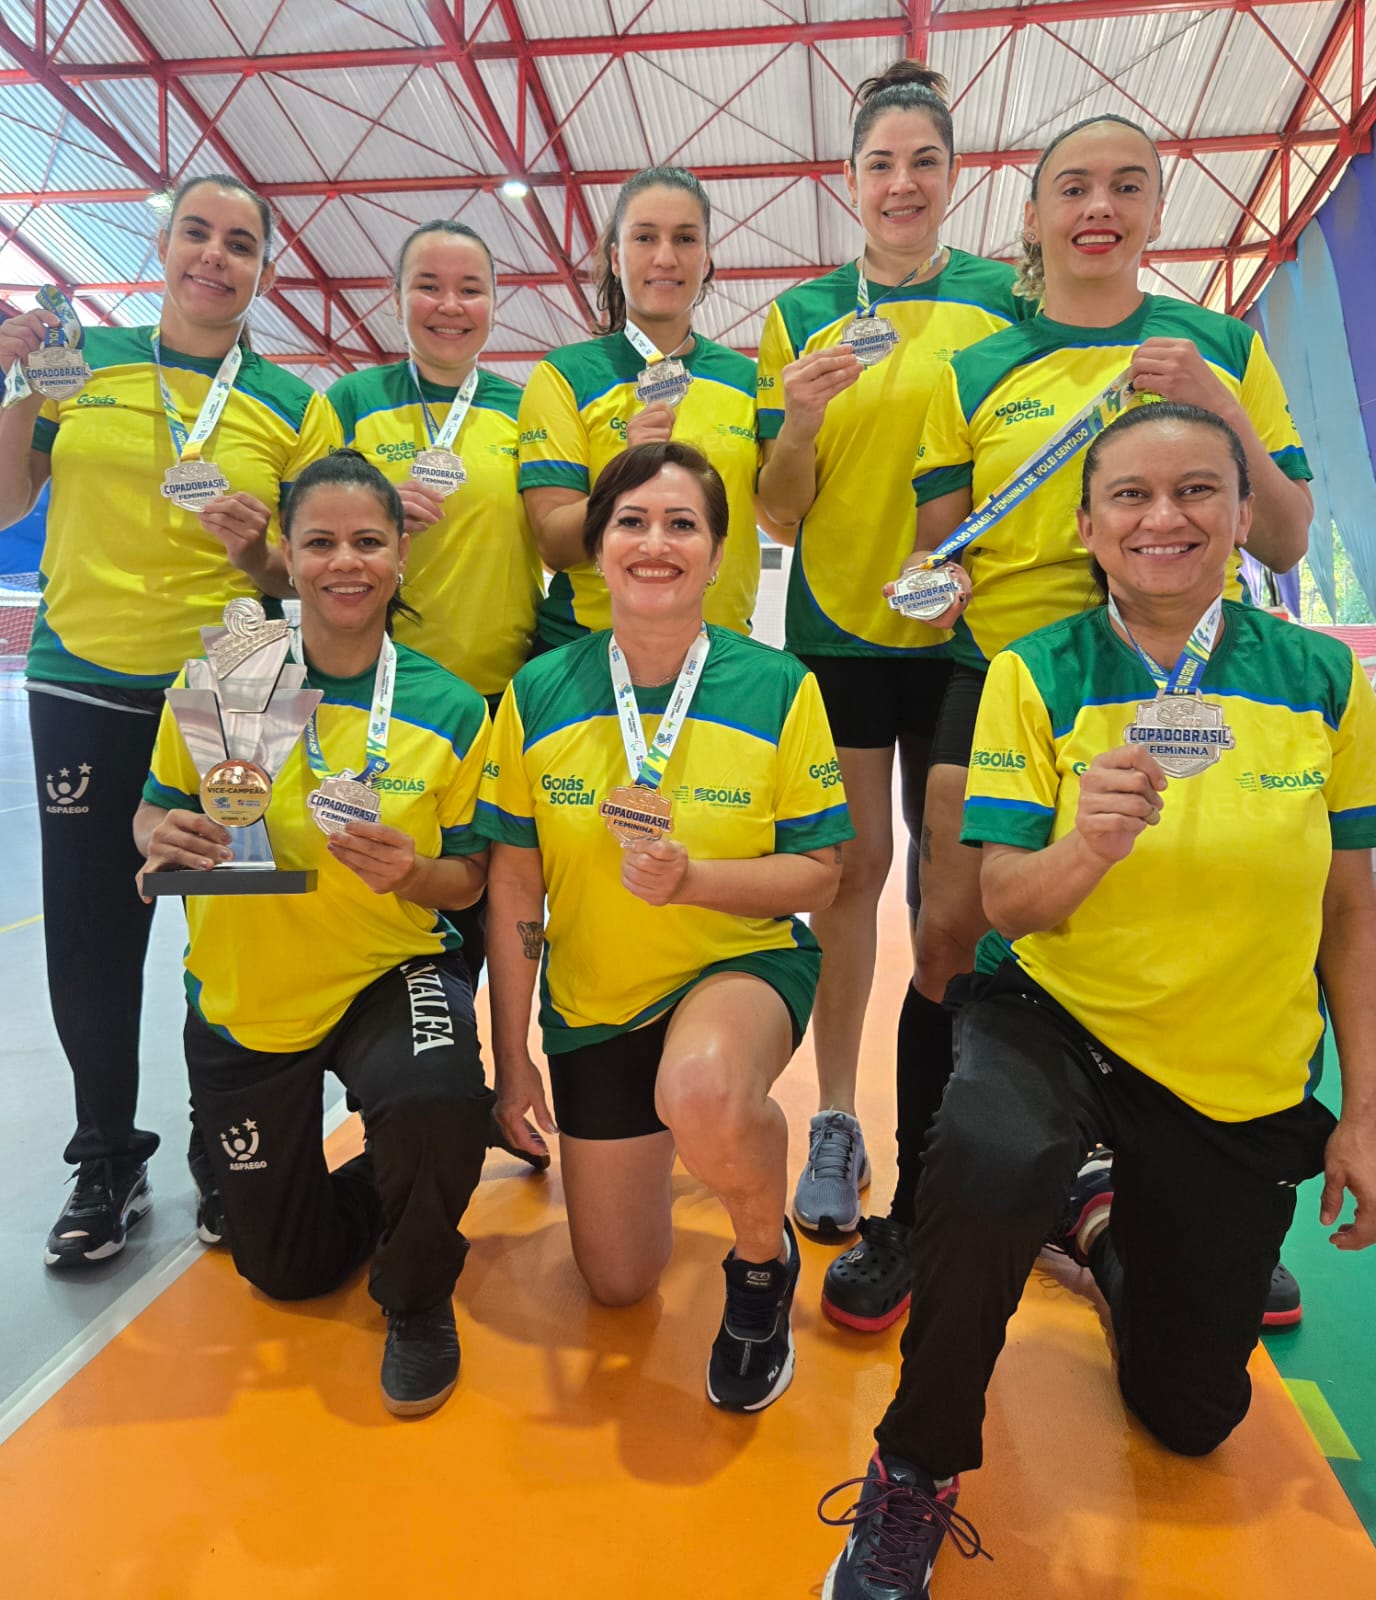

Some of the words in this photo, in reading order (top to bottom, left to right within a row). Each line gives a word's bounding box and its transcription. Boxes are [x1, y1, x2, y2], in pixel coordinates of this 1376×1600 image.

[841, 331, 897, 347] PADOBRASIL
[26, 367, 89, 379] COPADOBRASIL
[40, 379, 77, 387] FEMININA
[637, 374, 691, 397] COPADOBRASIL
[1005, 404, 1055, 425] social
[376, 440, 415, 455] Goiás
[412, 465, 465, 480] COPADOBRASIL
[164, 479, 227, 494] COPADOBRASIL
[422, 477, 454, 486] FEMININA
[955, 531, 971, 542] DO
[966, 512, 996, 533] BRASIL
[992, 483, 1028, 513] FEMININA
[1023, 473, 1038, 486] DE
[1034, 455, 1058, 476] VOLEI
[1054, 427, 1089, 459] SENTADO
[178, 491, 216, 500] FEMININA
[891, 581, 959, 606] COPADOBRASIL
[907, 595, 947, 609] FEMININA
[1129, 727, 1230, 744] COPADOBRASIL
[1149, 745, 1209, 756] FEMININA
[979, 749, 1026, 769] GOIÁS
[808, 756, 838, 779] Goiá
[381, 778, 426, 792] GOIÁS
[541, 774, 584, 791] Goiás
[1271, 769, 1325, 788] GOIÁS
[207, 786, 266, 794] VICE-CAMPEÃO
[549, 789, 596, 805] social
[705, 788, 752, 804] GOIÁS
[46, 805, 89, 814] ASPAEGO
[310, 794, 377, 823] COPADOBRASIL
[320, 810, 352, 823] FEMIN
[601, 803, 671, 830] COPADOBRASIL
[613, 819, 654, 834] FEMININA
[230, 1160, 267, 1170] ASPAEGO
